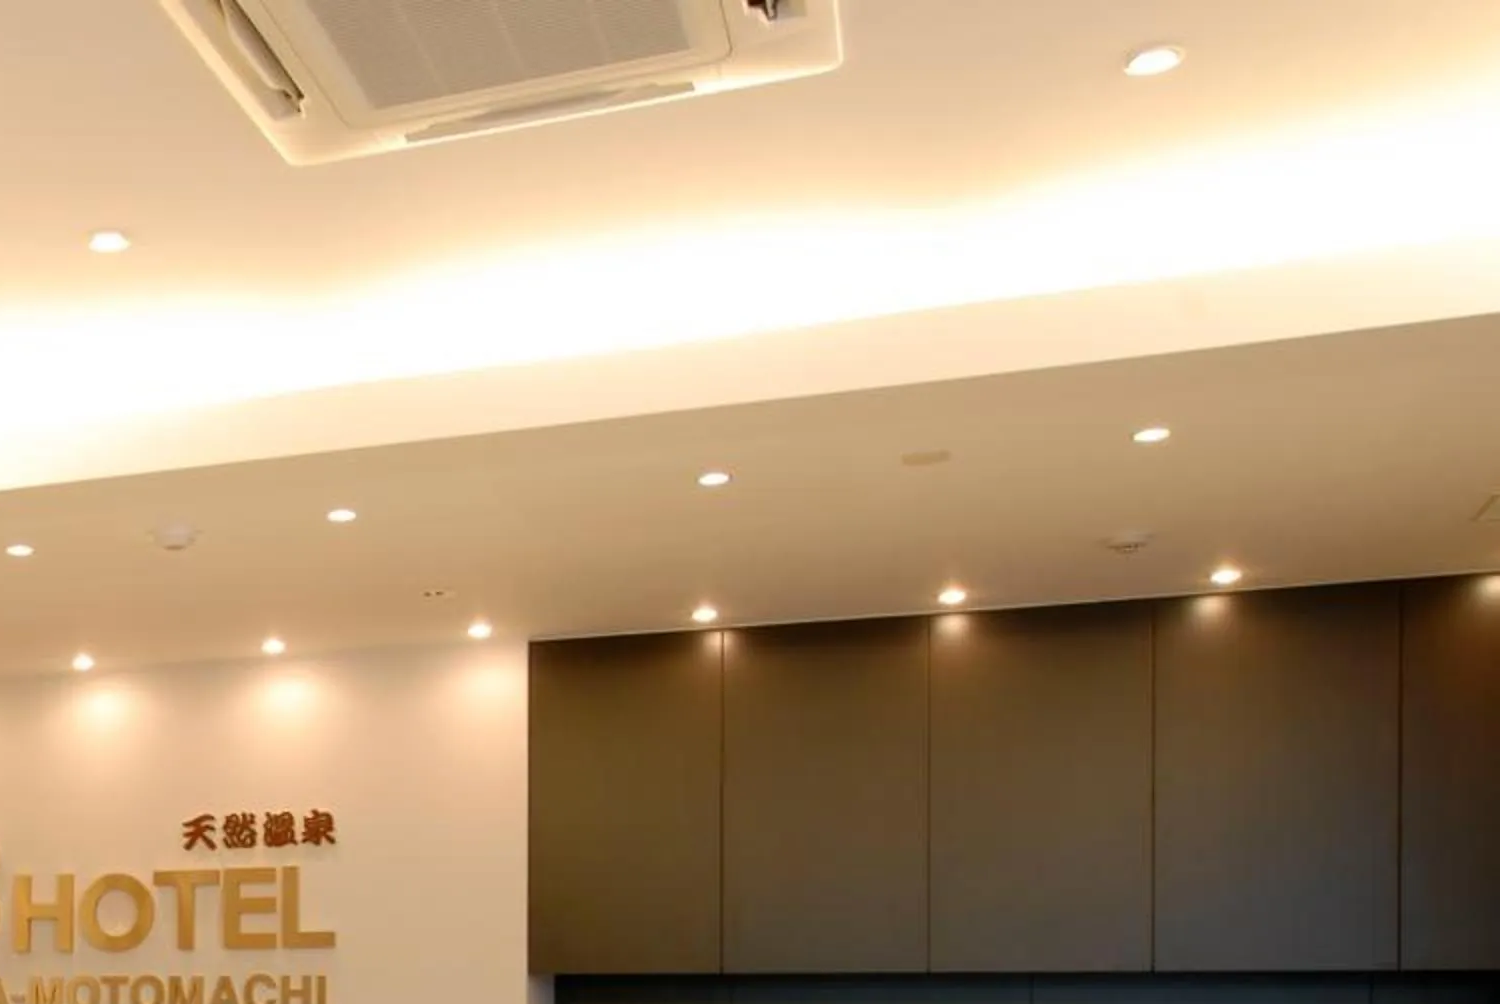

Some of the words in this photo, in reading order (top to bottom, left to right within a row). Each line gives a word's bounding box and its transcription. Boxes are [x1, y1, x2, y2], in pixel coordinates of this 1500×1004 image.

[182, 810, 336, 851] 天然温泉
[11, 865, 336, 954] HOTEL
